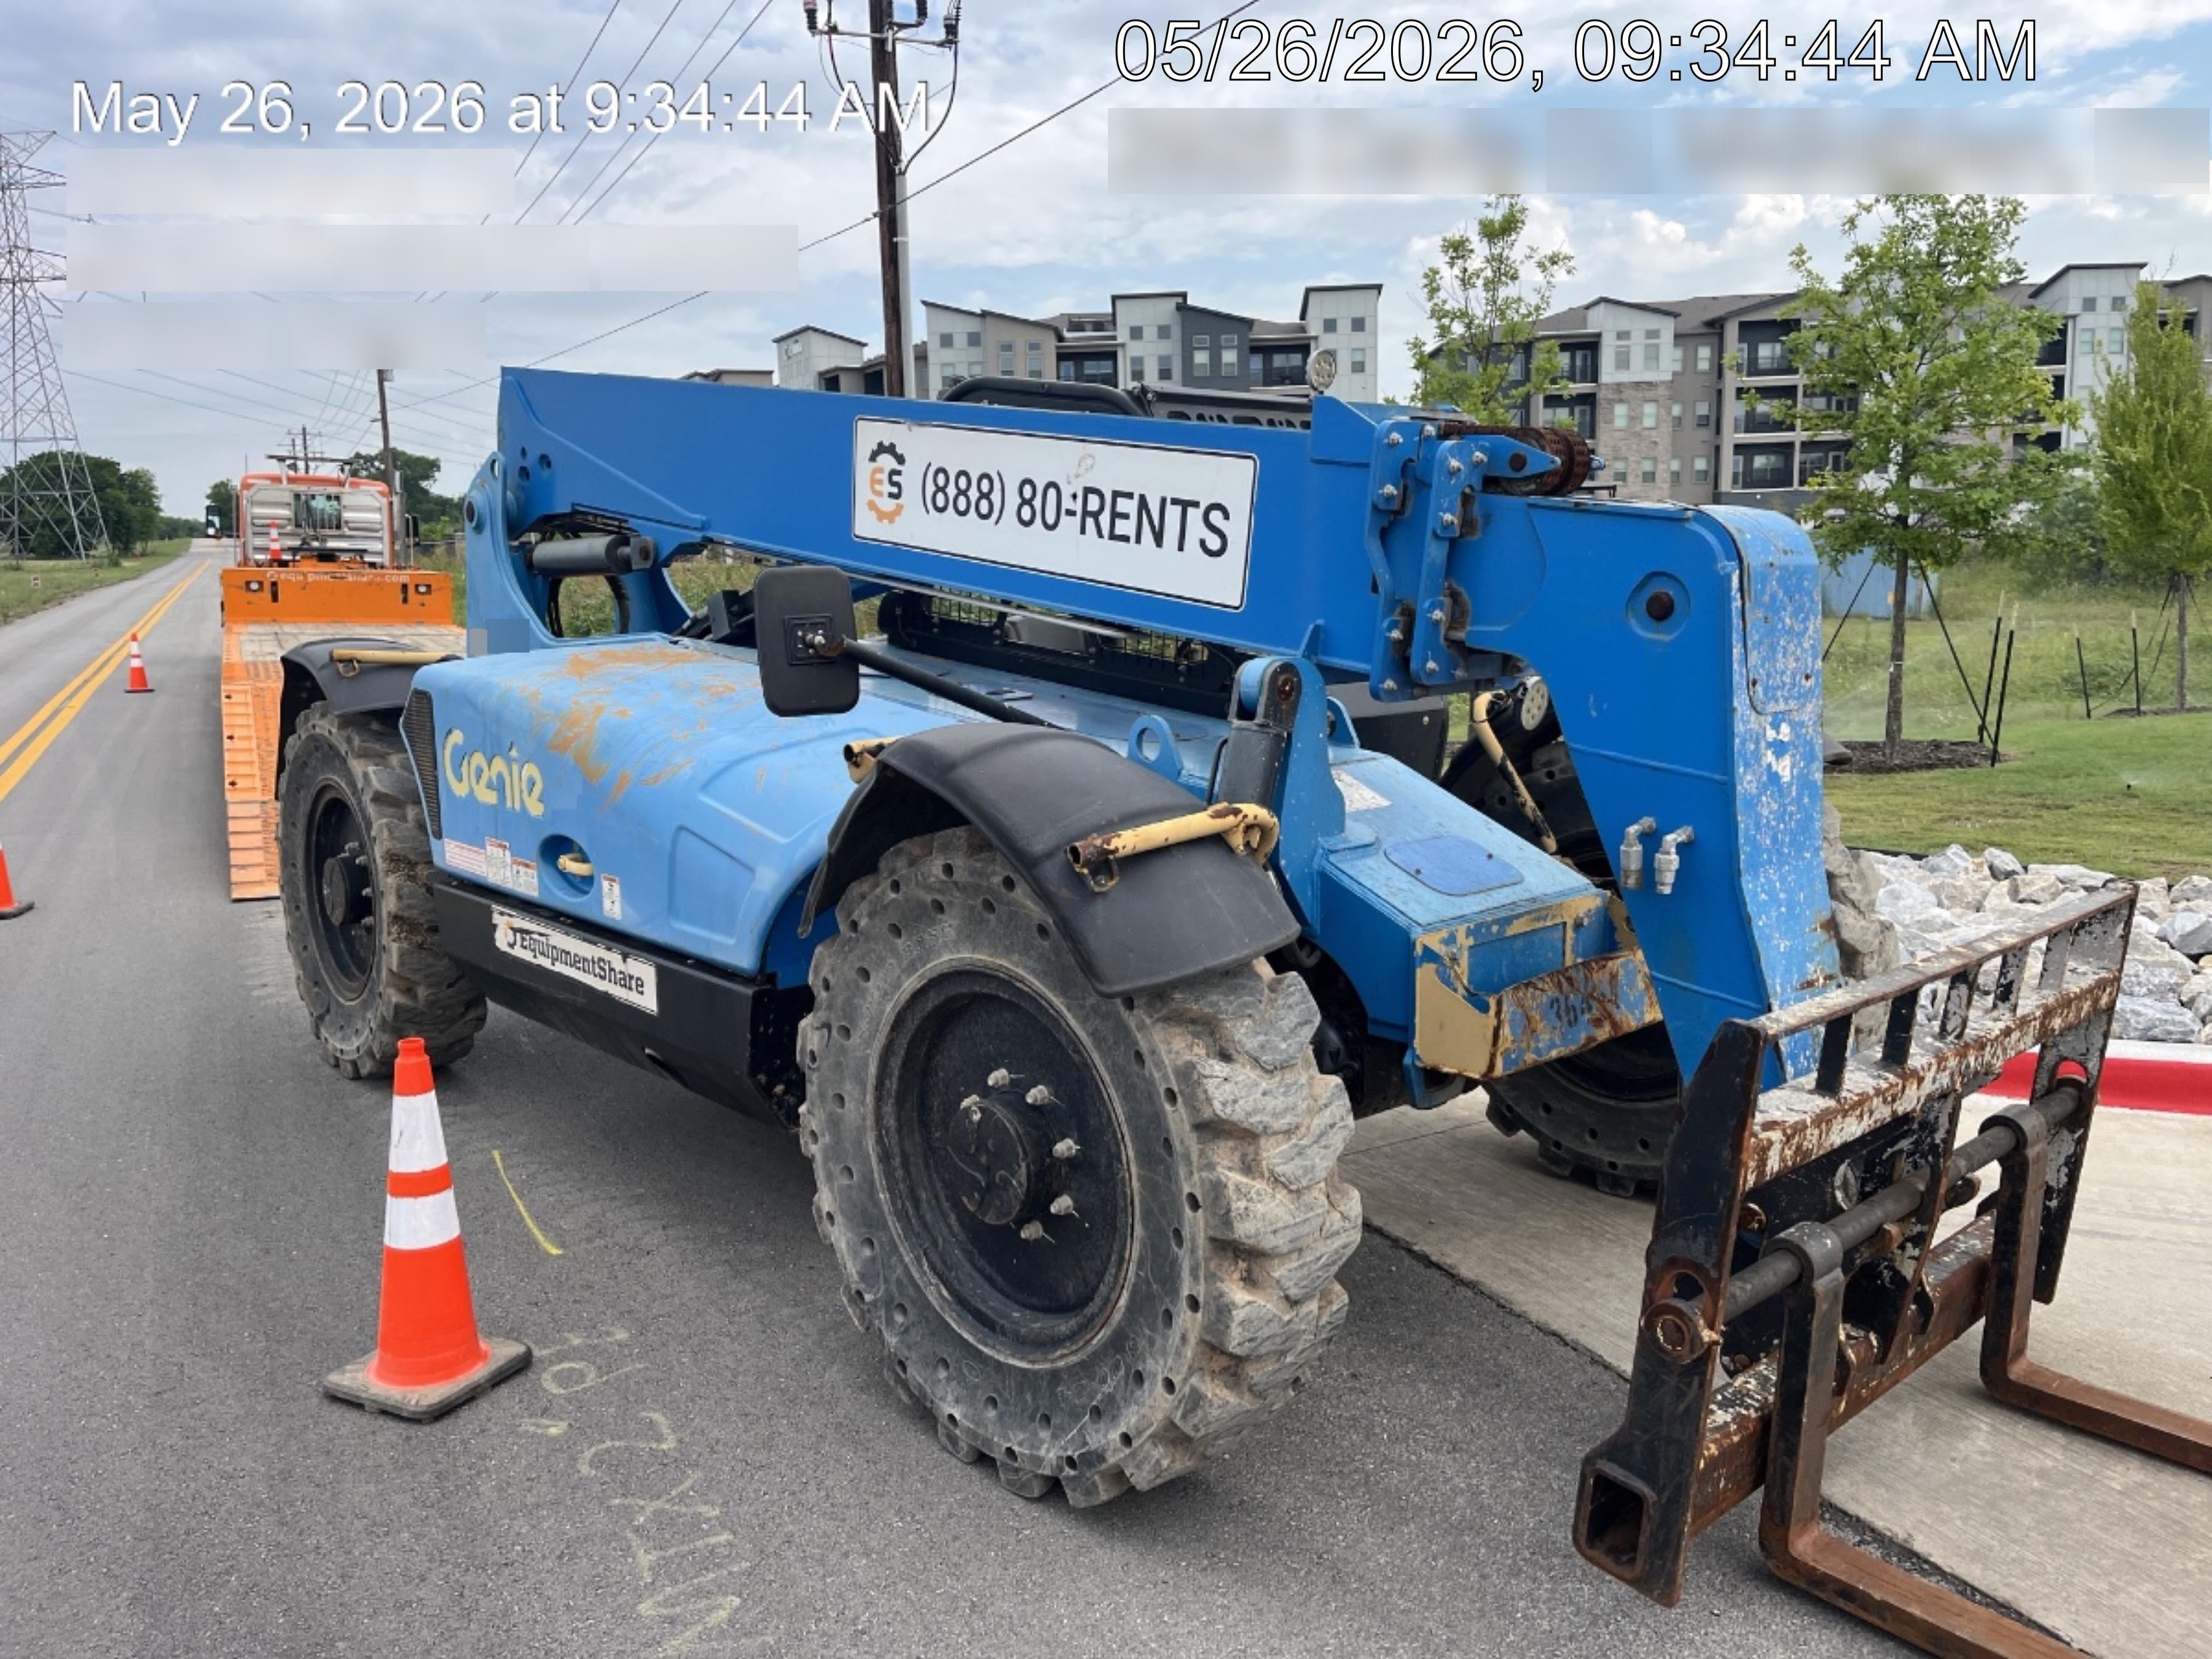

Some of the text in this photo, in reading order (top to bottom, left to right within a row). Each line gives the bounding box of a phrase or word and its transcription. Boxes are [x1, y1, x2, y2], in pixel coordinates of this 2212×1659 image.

[921, 461, 1231, 558] (888) 80-RENTS
[443, 728, 544, 818] Genie
[519, 932, 645, 996] EquipmentShare
